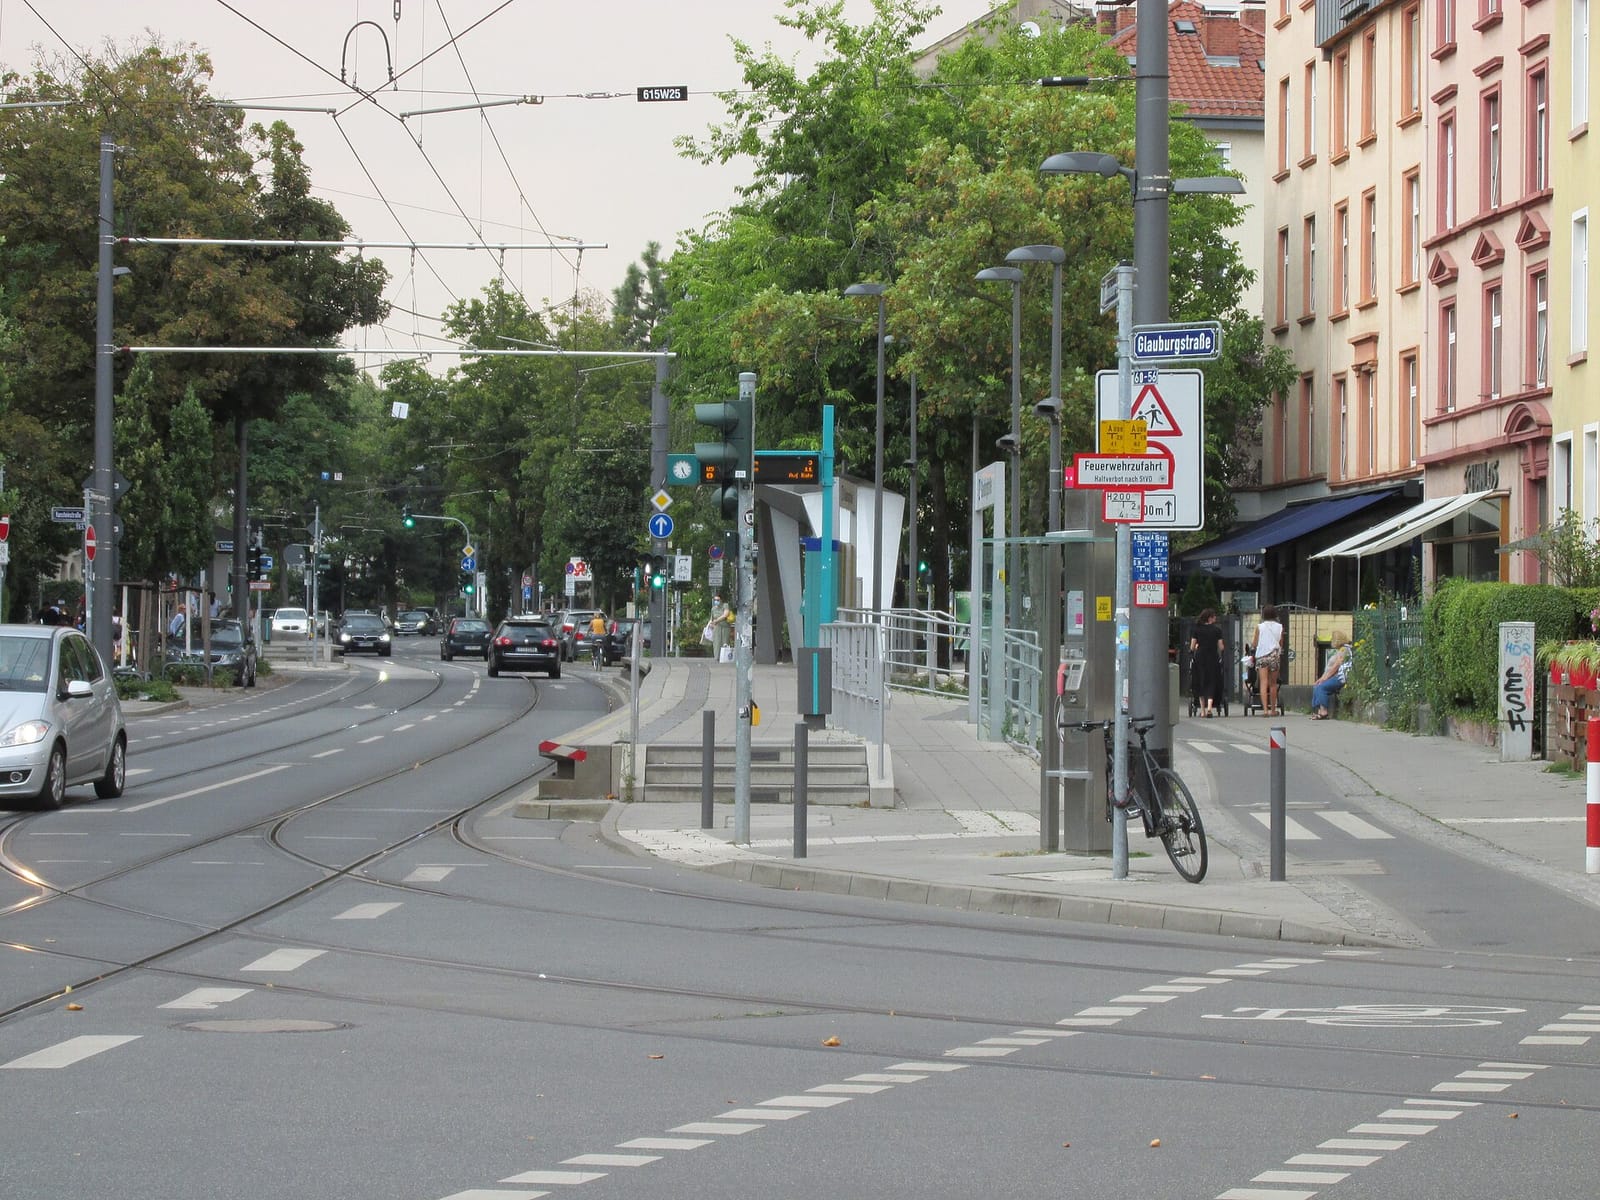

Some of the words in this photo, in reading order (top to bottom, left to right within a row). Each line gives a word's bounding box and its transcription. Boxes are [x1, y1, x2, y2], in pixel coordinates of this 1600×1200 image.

[643, 88, 681, 100] 615W25
[1137, 332, 1211, 354] Glauburgstraße
[1134, 371, 1157, 383] 60-56
[1084, 460, 1162, 471] Feuerwehrzufahrt
